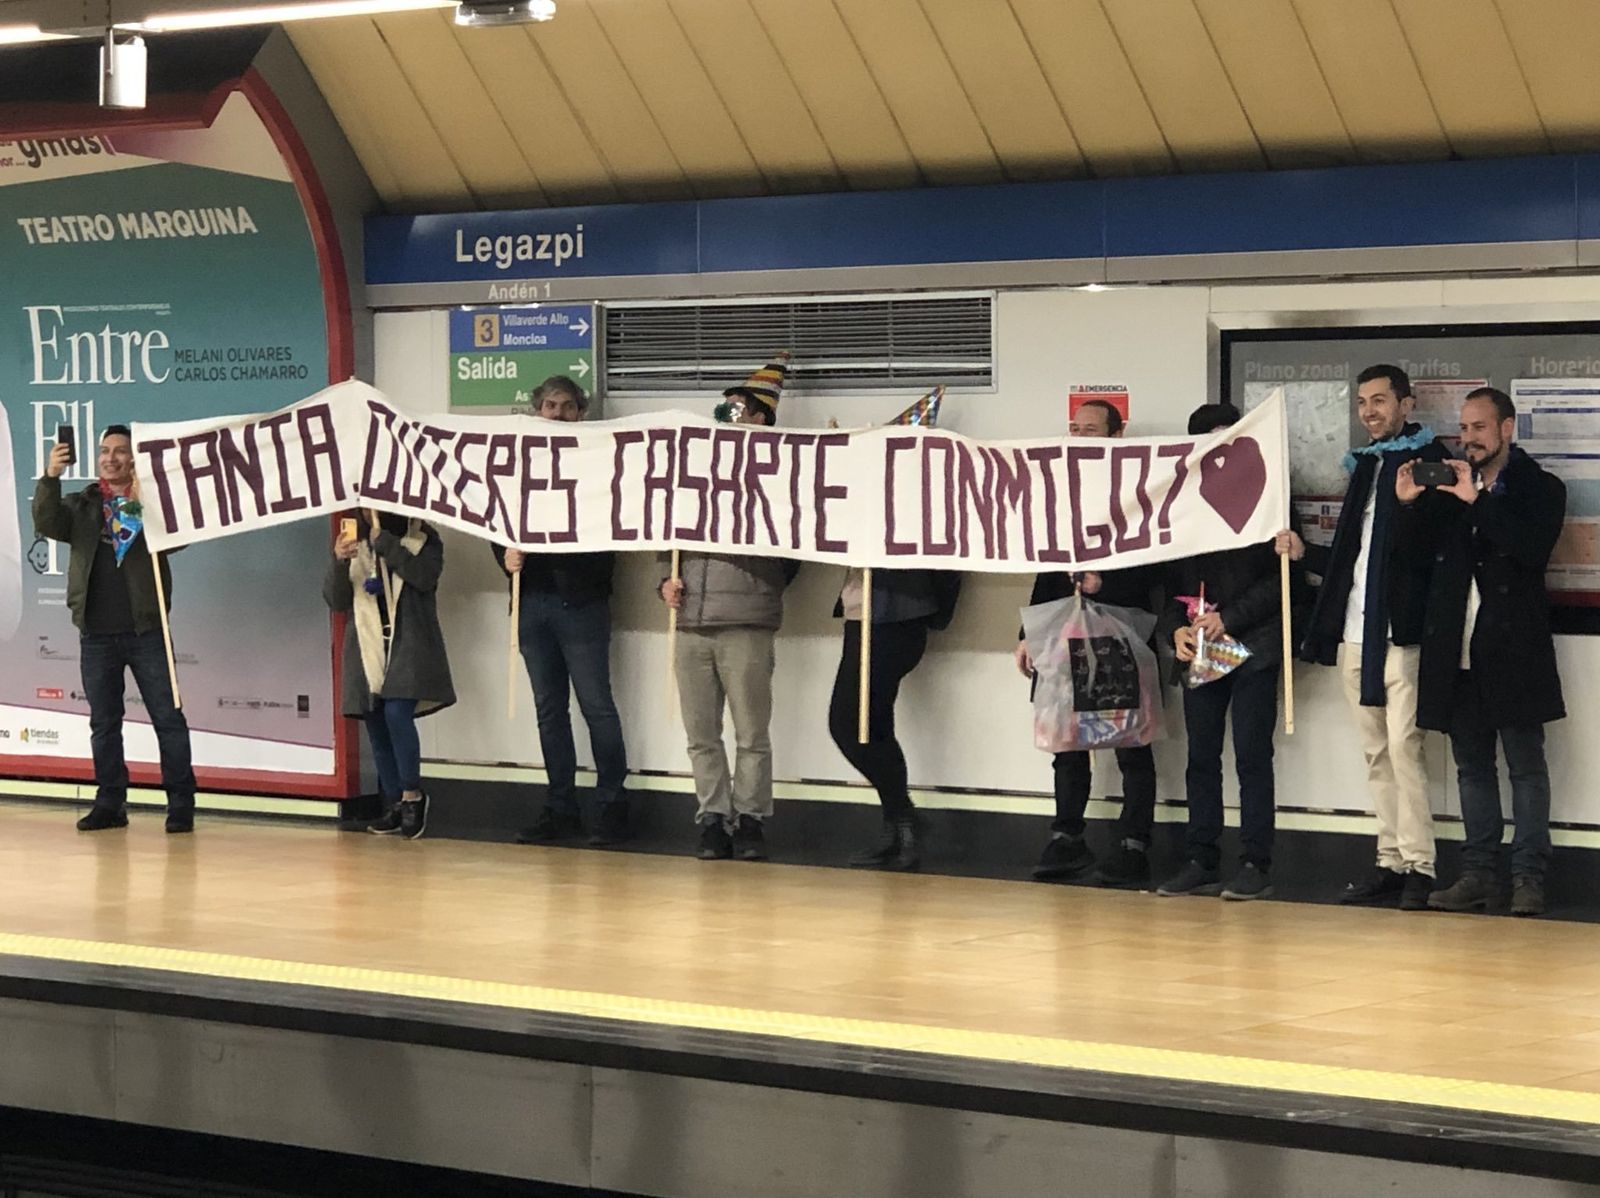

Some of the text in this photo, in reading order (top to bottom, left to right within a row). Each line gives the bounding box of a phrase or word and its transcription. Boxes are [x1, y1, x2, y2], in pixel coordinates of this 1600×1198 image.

[17, 206, 258, 244] TEATRO MARQUINA
[456, 224, 584, 269] Legazpi
[488, 281, 551, 300] Andén 1
[480, 319, 494, 343] 3
[503, 313, 548, 327] Villaverde
[22, 304, 171, 385] Entre
[174, 346, 292, 364] MELANI OLIVARES
[174, 364, 309, 383] CARLOS CHAMARRO
[457, 356, 518, 380] Salida
[1244, 361, 1349, 380] Plano zonal
[1399, 358, 1462, 378] Tarifas
[360, 400, 579, 544] QUIERES
[611, 426, 850, 553] CASARTE
[885, 436, 1196, 562] CONMIGO?
